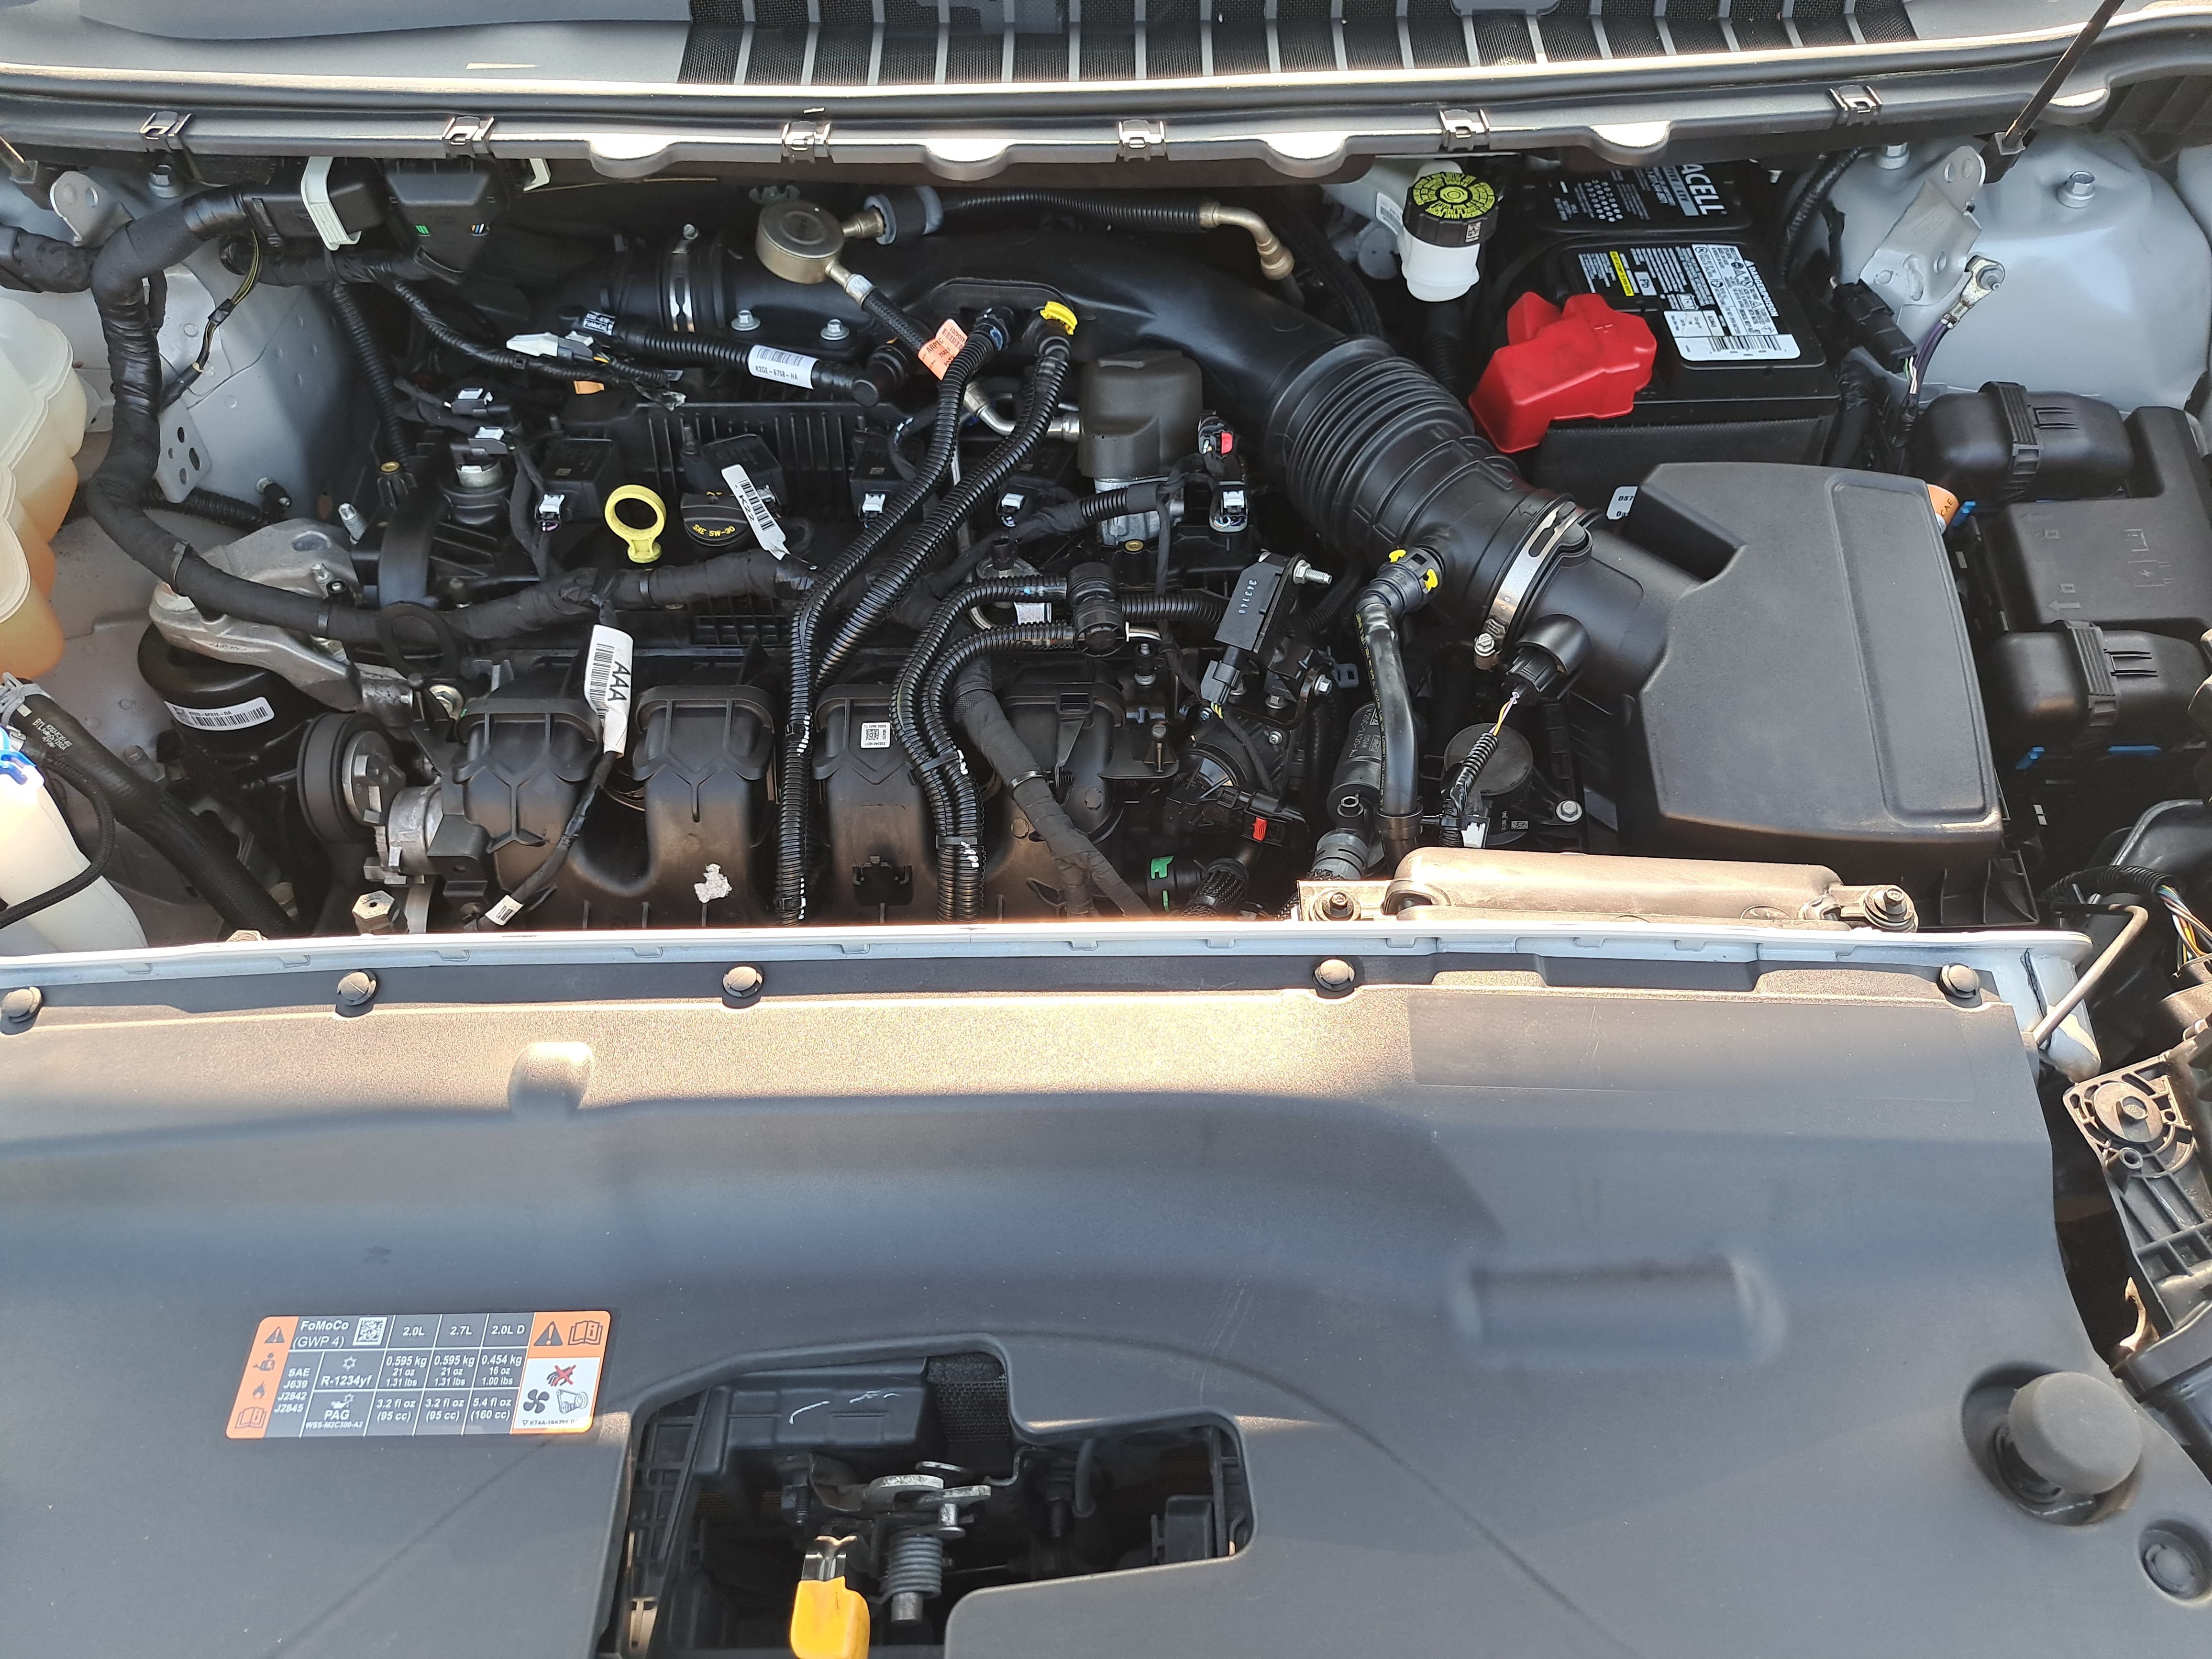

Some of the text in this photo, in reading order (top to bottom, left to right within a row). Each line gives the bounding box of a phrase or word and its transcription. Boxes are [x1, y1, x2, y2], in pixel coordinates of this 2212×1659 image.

[1639, 279, 1650, 288] Pb
[692, 524, 736, 537] SAE 5W-30
[608, 661, 631, 701] AAA
[300, 1320, 349, 1331] FoMoCo
[450, 1325, 473, 1336] 2.7L
[491, 1325, 525, 1335] 2.0L D
[402, 1326, 425, 1336] 2.0L
[293, 1336, 345, 1349] (GWP 4)
[386, 1356, 427, 1368] 0.595 kg
[434, 1355, 475, 1367] 0.595 kg
[481, 1354, 522, 1366] 0.454 kg
[288, 1368, 311, 1377] SAE
[392, 1368, 403, 1377] 21
[440, 1367, 451, 1376] 21
[489, 1366, 498, 1375] 16
[283, 1380, 309, 1389] J639
[321, 1375, 373, 1388] R-1234yf
[386, 1378, 418, 1387] 1.31 lbs
[435, 1378, 465, 1386] 1.31 lbs
[482, 1376, 513, 1386] 1.00 lbs
[277, 1392, 308, 1401] J2842
[376, 1399, 416, 1409] 3.2 fl oz
[425, 1398, 465, 1408] 3.2 fl oz
[472, 1398, 512, 1407] 5.4 fl oz
[274, 1403, 304, 1413] J2845
[324, 1409, 350, 1420] PAG
[376, 1411, 411, 1423] (95 cc)
[425, 1411, 460, 1423] (95 cc)
[471, 1410, 510, 1422] (160 cc)
